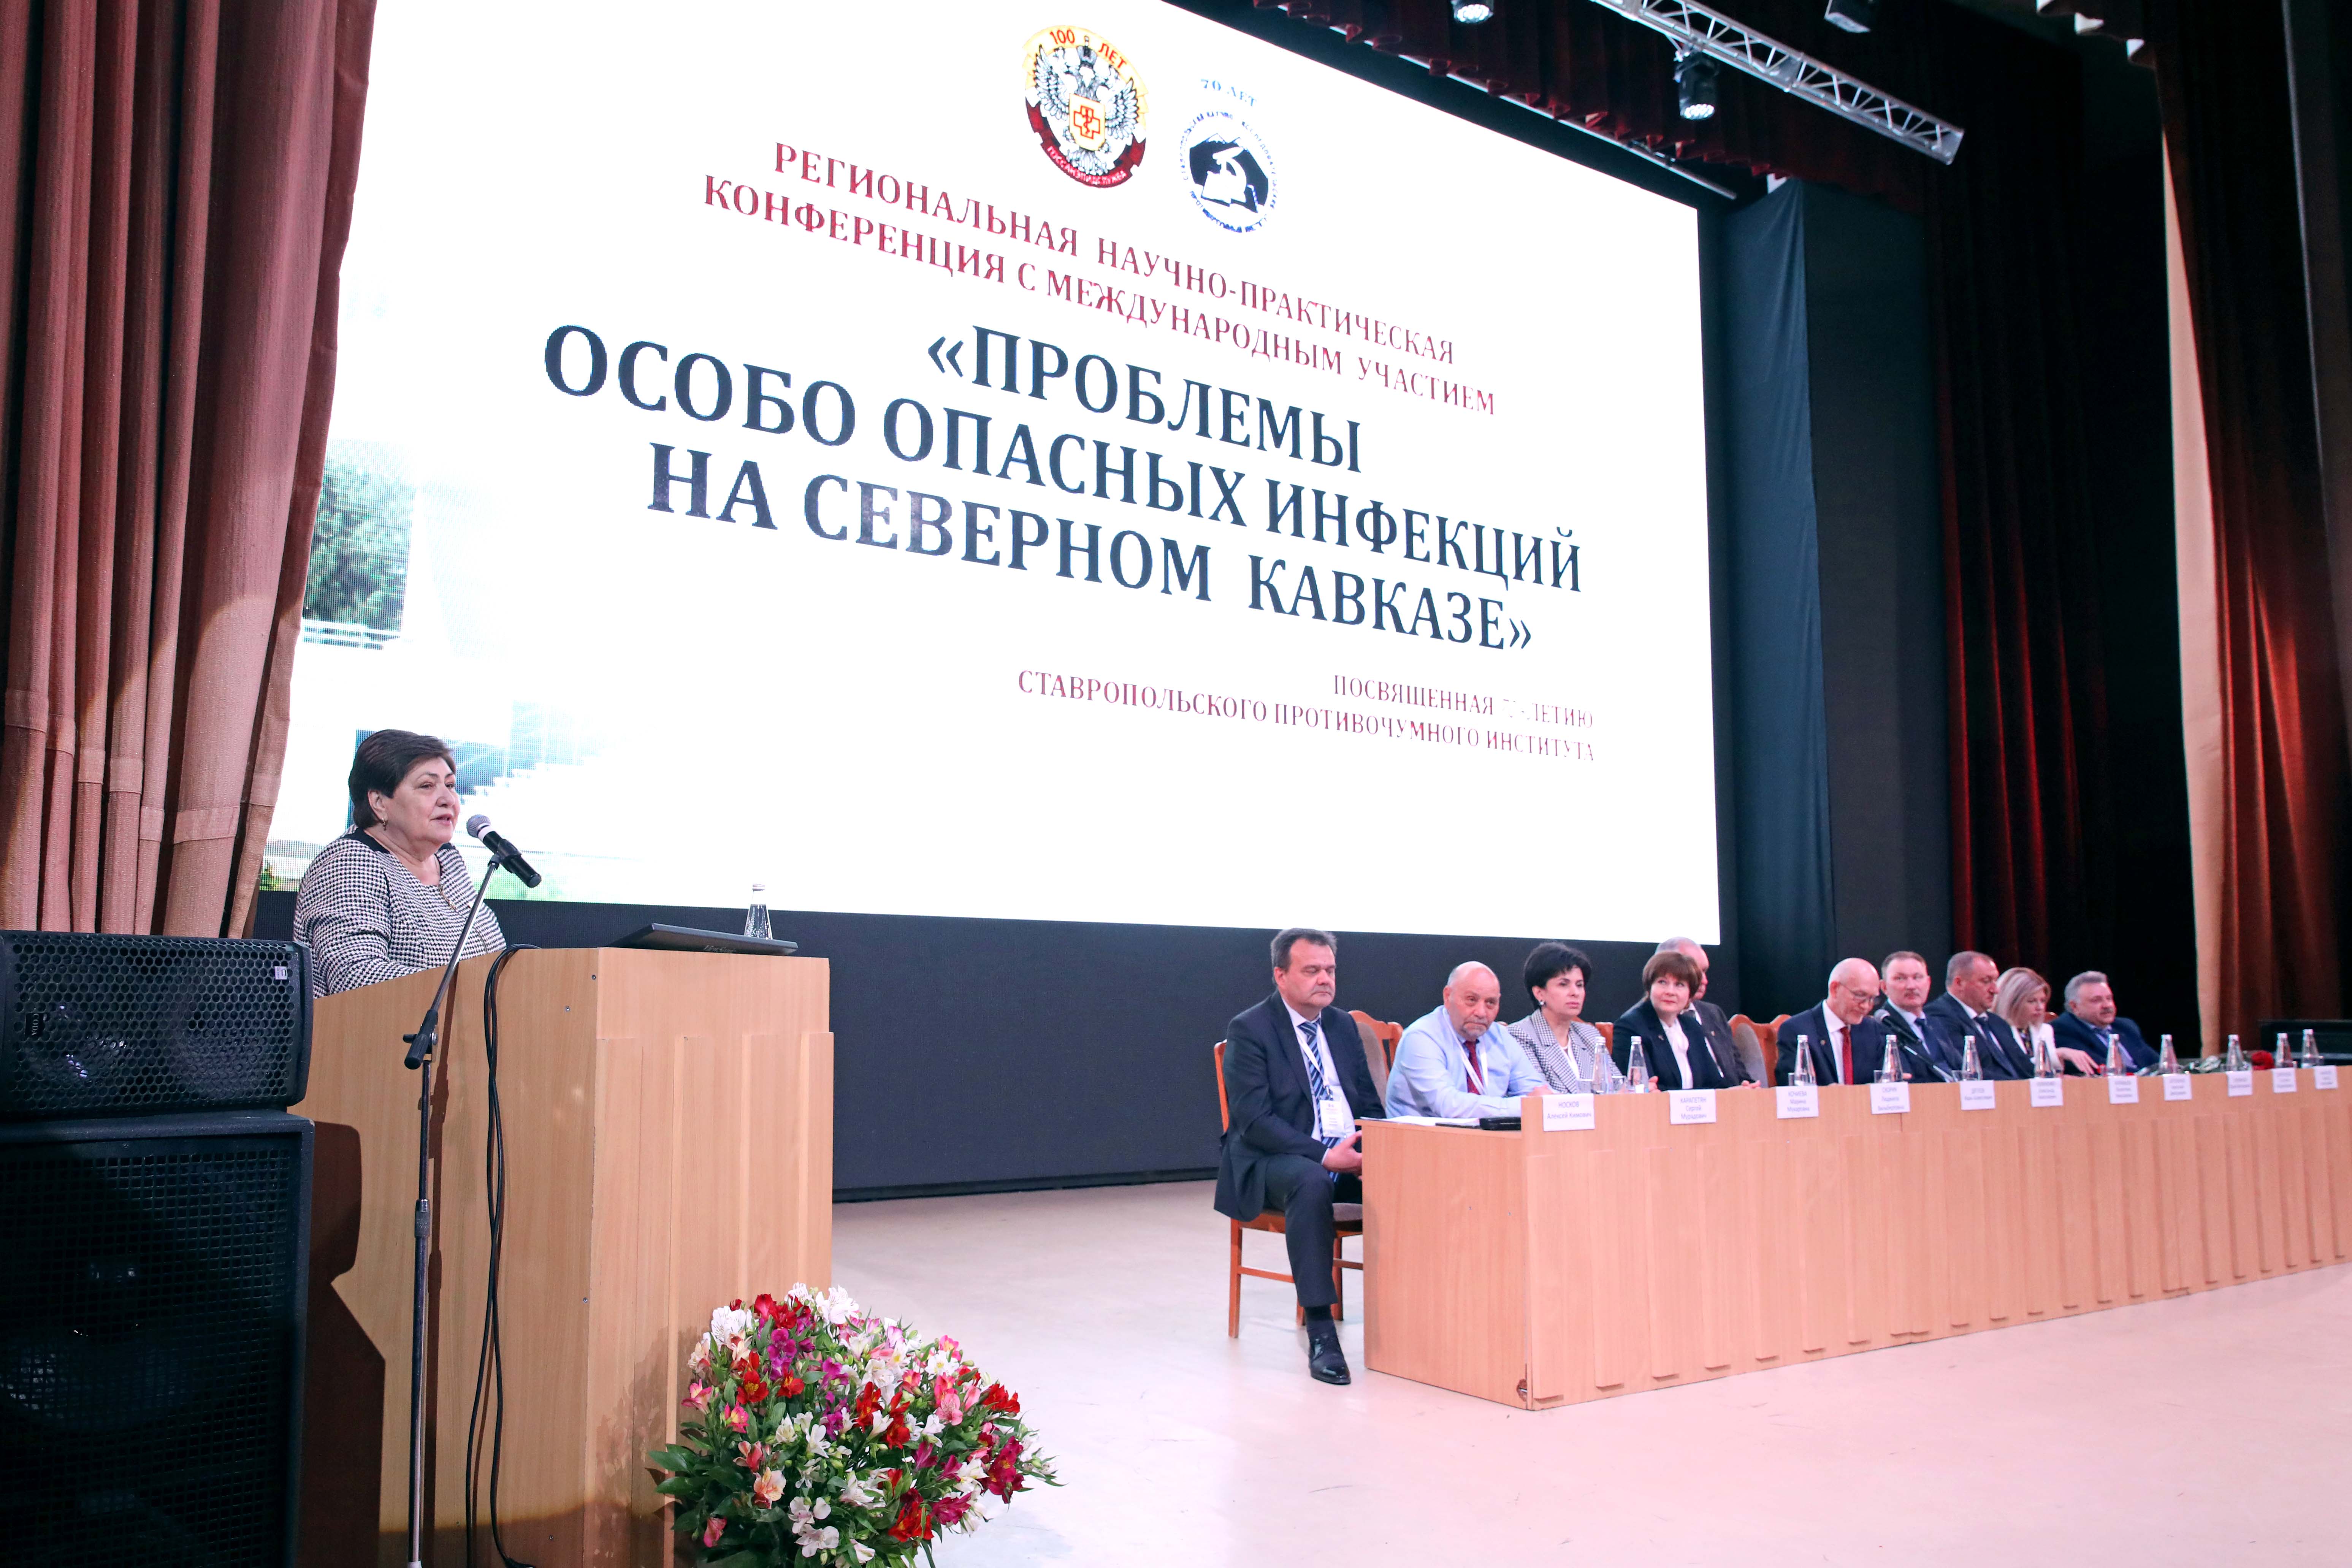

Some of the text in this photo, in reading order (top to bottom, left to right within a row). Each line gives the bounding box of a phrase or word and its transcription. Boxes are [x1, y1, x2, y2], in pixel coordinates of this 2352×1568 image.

[1049, 29, 1127, 68] 100 ЛЕТ
[1200, 78, 1257, 107] 70 ЛЕТ
[704, 174, 1494, 415] КОНФЕРЕНЦИЯ С МЕЖДУНАРОДНЫМ УЧАСТИЕМ
[774, 142, 1453, 364] РЕГИОНАЛЬНАЯ НАУЧНО-ПРАКТИЧЕСКАЯ
[544, 324, 1581, 592] ОСОБО ОПАСНЫХ ИНФЕКЦИЙ
[927, 325, 1361, 474] «ПРОБЛЕМЫ
[647, 442, 1531, 650] НА СЕВЕРНОМ КАВКАЗЕ»
[1019, 670, 1594, 761] СТАВРОПОЛЬСКОГО ПРОТИВОЧУМНОГО ИНСТИТУТА
[1334, 675, 1593, 729] ПОСВЯЩЕННАЯ -ЛЕТИЮ
